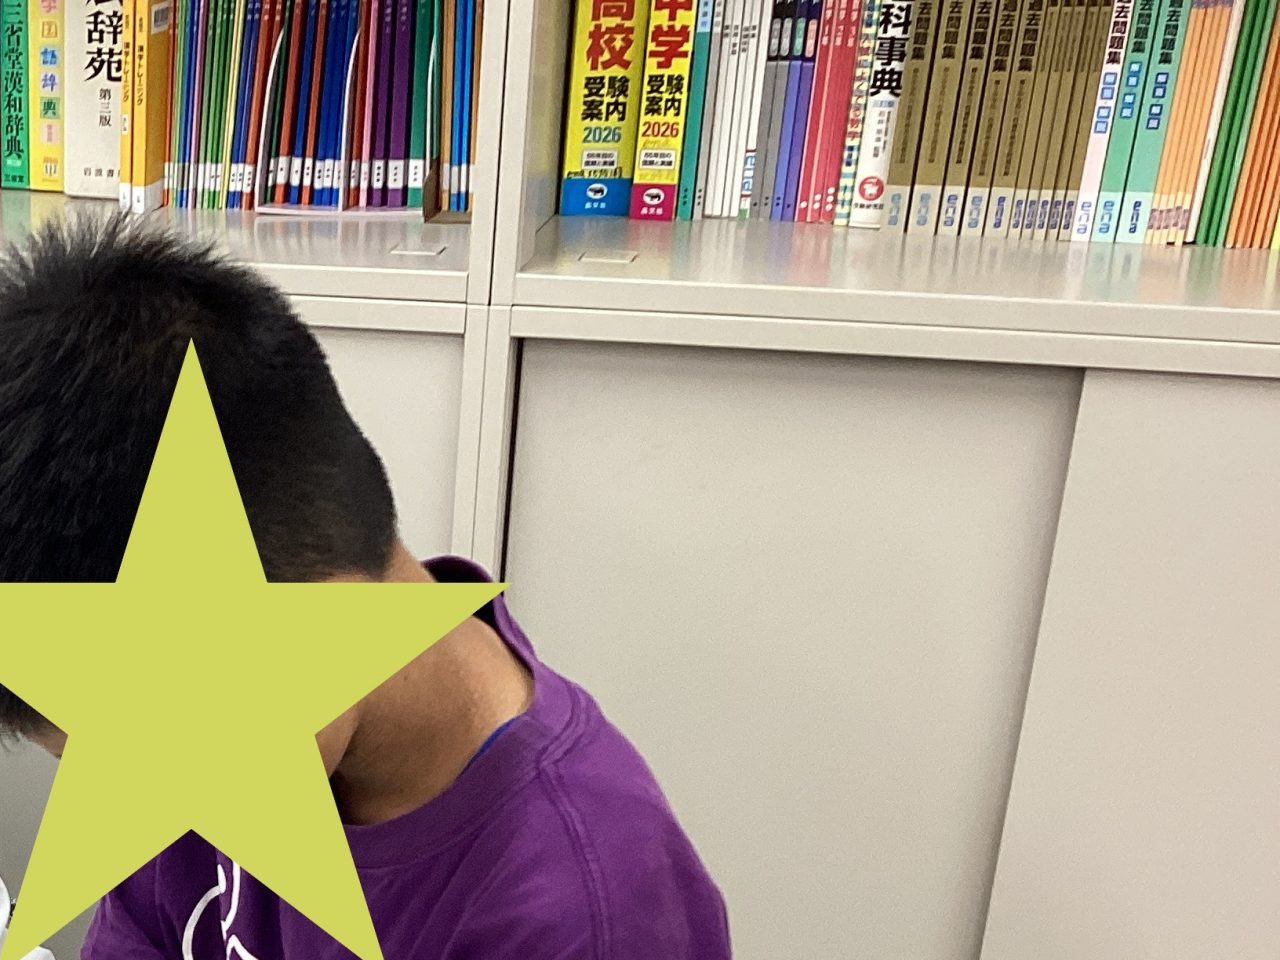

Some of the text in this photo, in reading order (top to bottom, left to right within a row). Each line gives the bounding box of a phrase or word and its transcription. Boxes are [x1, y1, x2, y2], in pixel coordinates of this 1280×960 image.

[84, 0, 122, 82] 辞苑
[870, 0, 913, 97] 科事典
[1106, 0, 1134, 64] 去問題集
[3, 2, 24, 159] 三省堂漢和辞典
[99, 88, 111, 127] 第三版
[582, 126, 622, 143] 2026
[641, 121, 680, 138] 2026
[84, 167, 120, 178] 岩波書
[1077, 201, 1092, 234] ena
[1099, 200, 1115, 233] ena
[1129, 200, 1142, 234] ena
